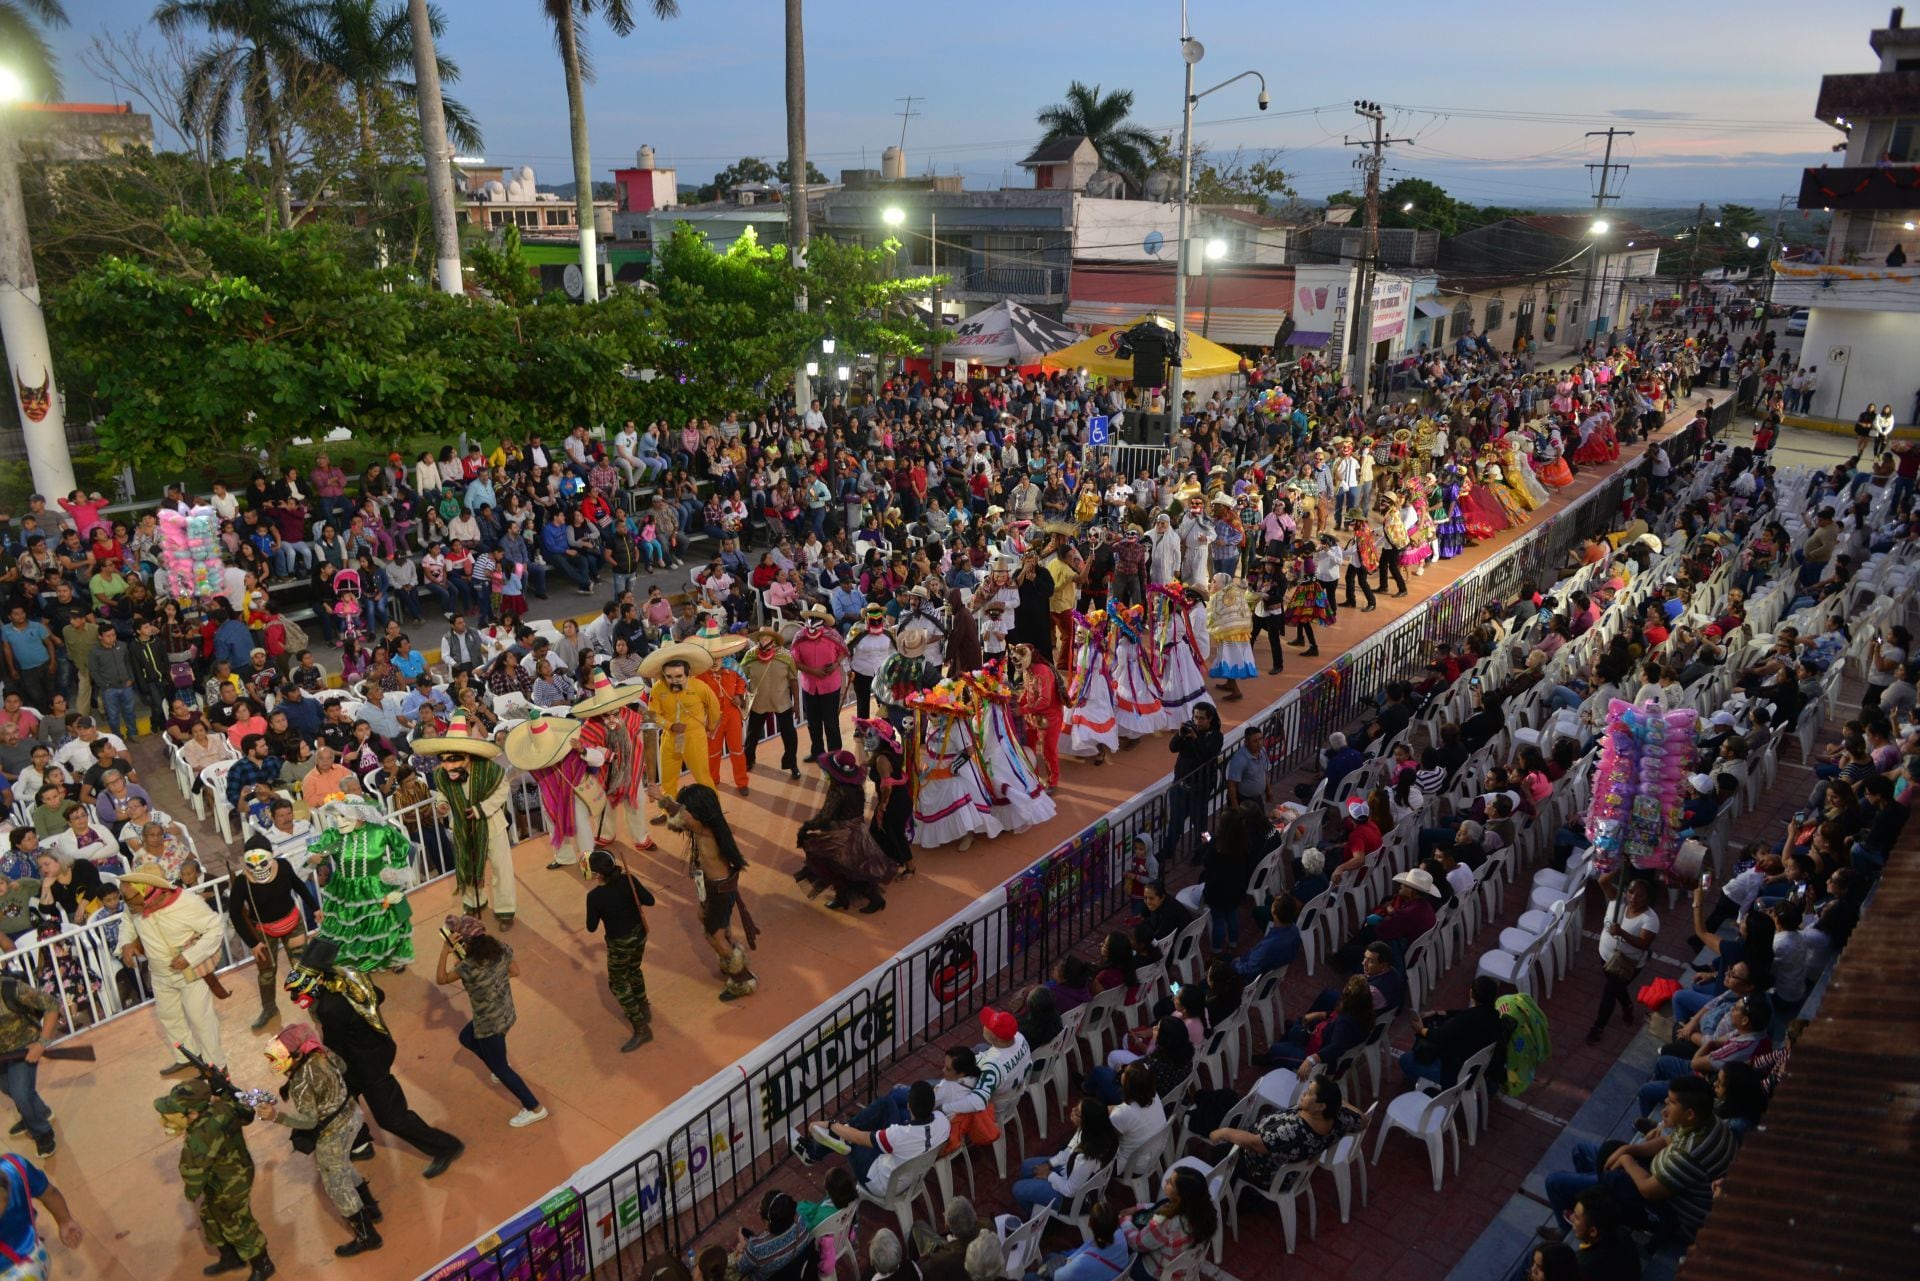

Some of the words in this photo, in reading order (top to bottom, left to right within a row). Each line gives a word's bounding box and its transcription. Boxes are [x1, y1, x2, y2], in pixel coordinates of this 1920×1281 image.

[957, 331, 1004, 346] ECATE
[778, 1011, 880, 1112] INDIO
[597, 1122, 744, 1240] TEMPOAL
